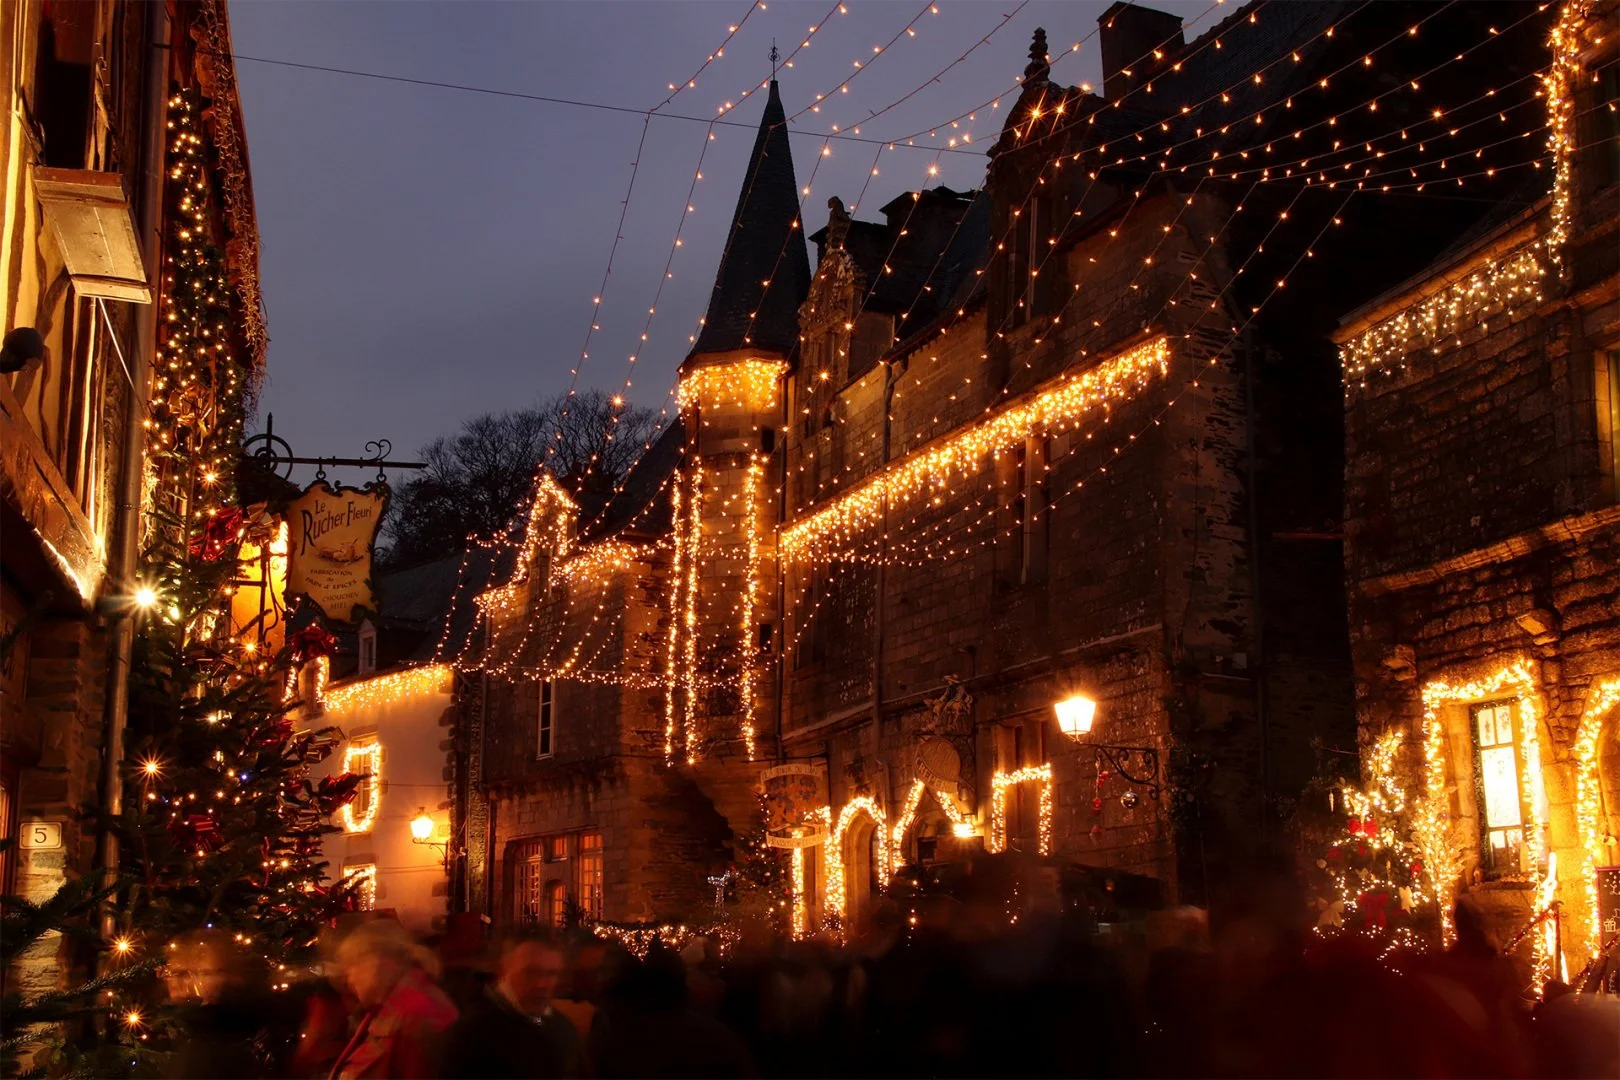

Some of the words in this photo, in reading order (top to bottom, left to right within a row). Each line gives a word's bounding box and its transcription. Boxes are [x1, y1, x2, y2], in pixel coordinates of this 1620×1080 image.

[314, 500, 326, 515] Le
[300, 509, 346, 556] Rucher
[346, 501, 372, 527] Fleuri
[310, 568, 353, 576] FABRICATION
[304, 576, 322, 588] PAIN
[322, 591, 359, 602] CHOUCHEN
[34, 827, 47, 844] 5
